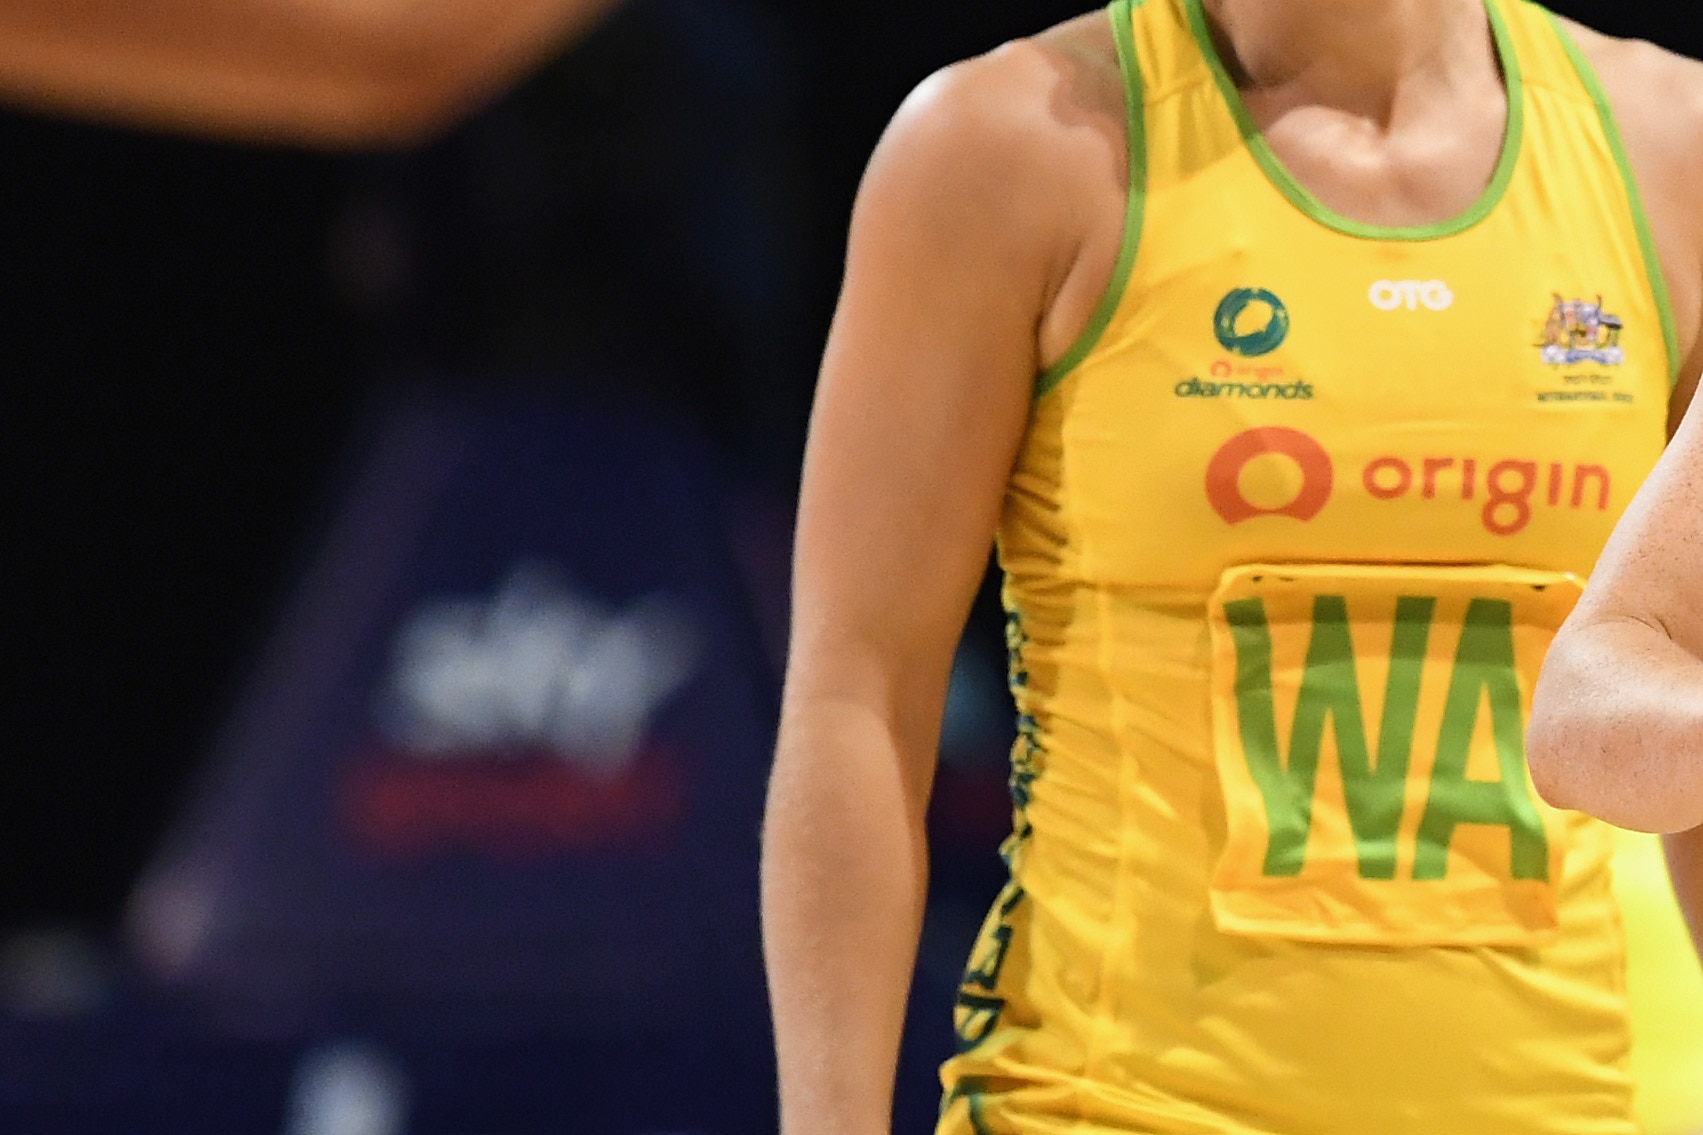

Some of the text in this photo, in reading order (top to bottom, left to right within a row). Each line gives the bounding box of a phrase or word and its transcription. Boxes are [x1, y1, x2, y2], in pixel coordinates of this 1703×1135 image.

[1367, 278, 1454, 312] OTG
[1174, 376, 1315, 400] diamonds
[1362, 457, 1611, 537] origin
[1223, 595, 1549, 881] WA
